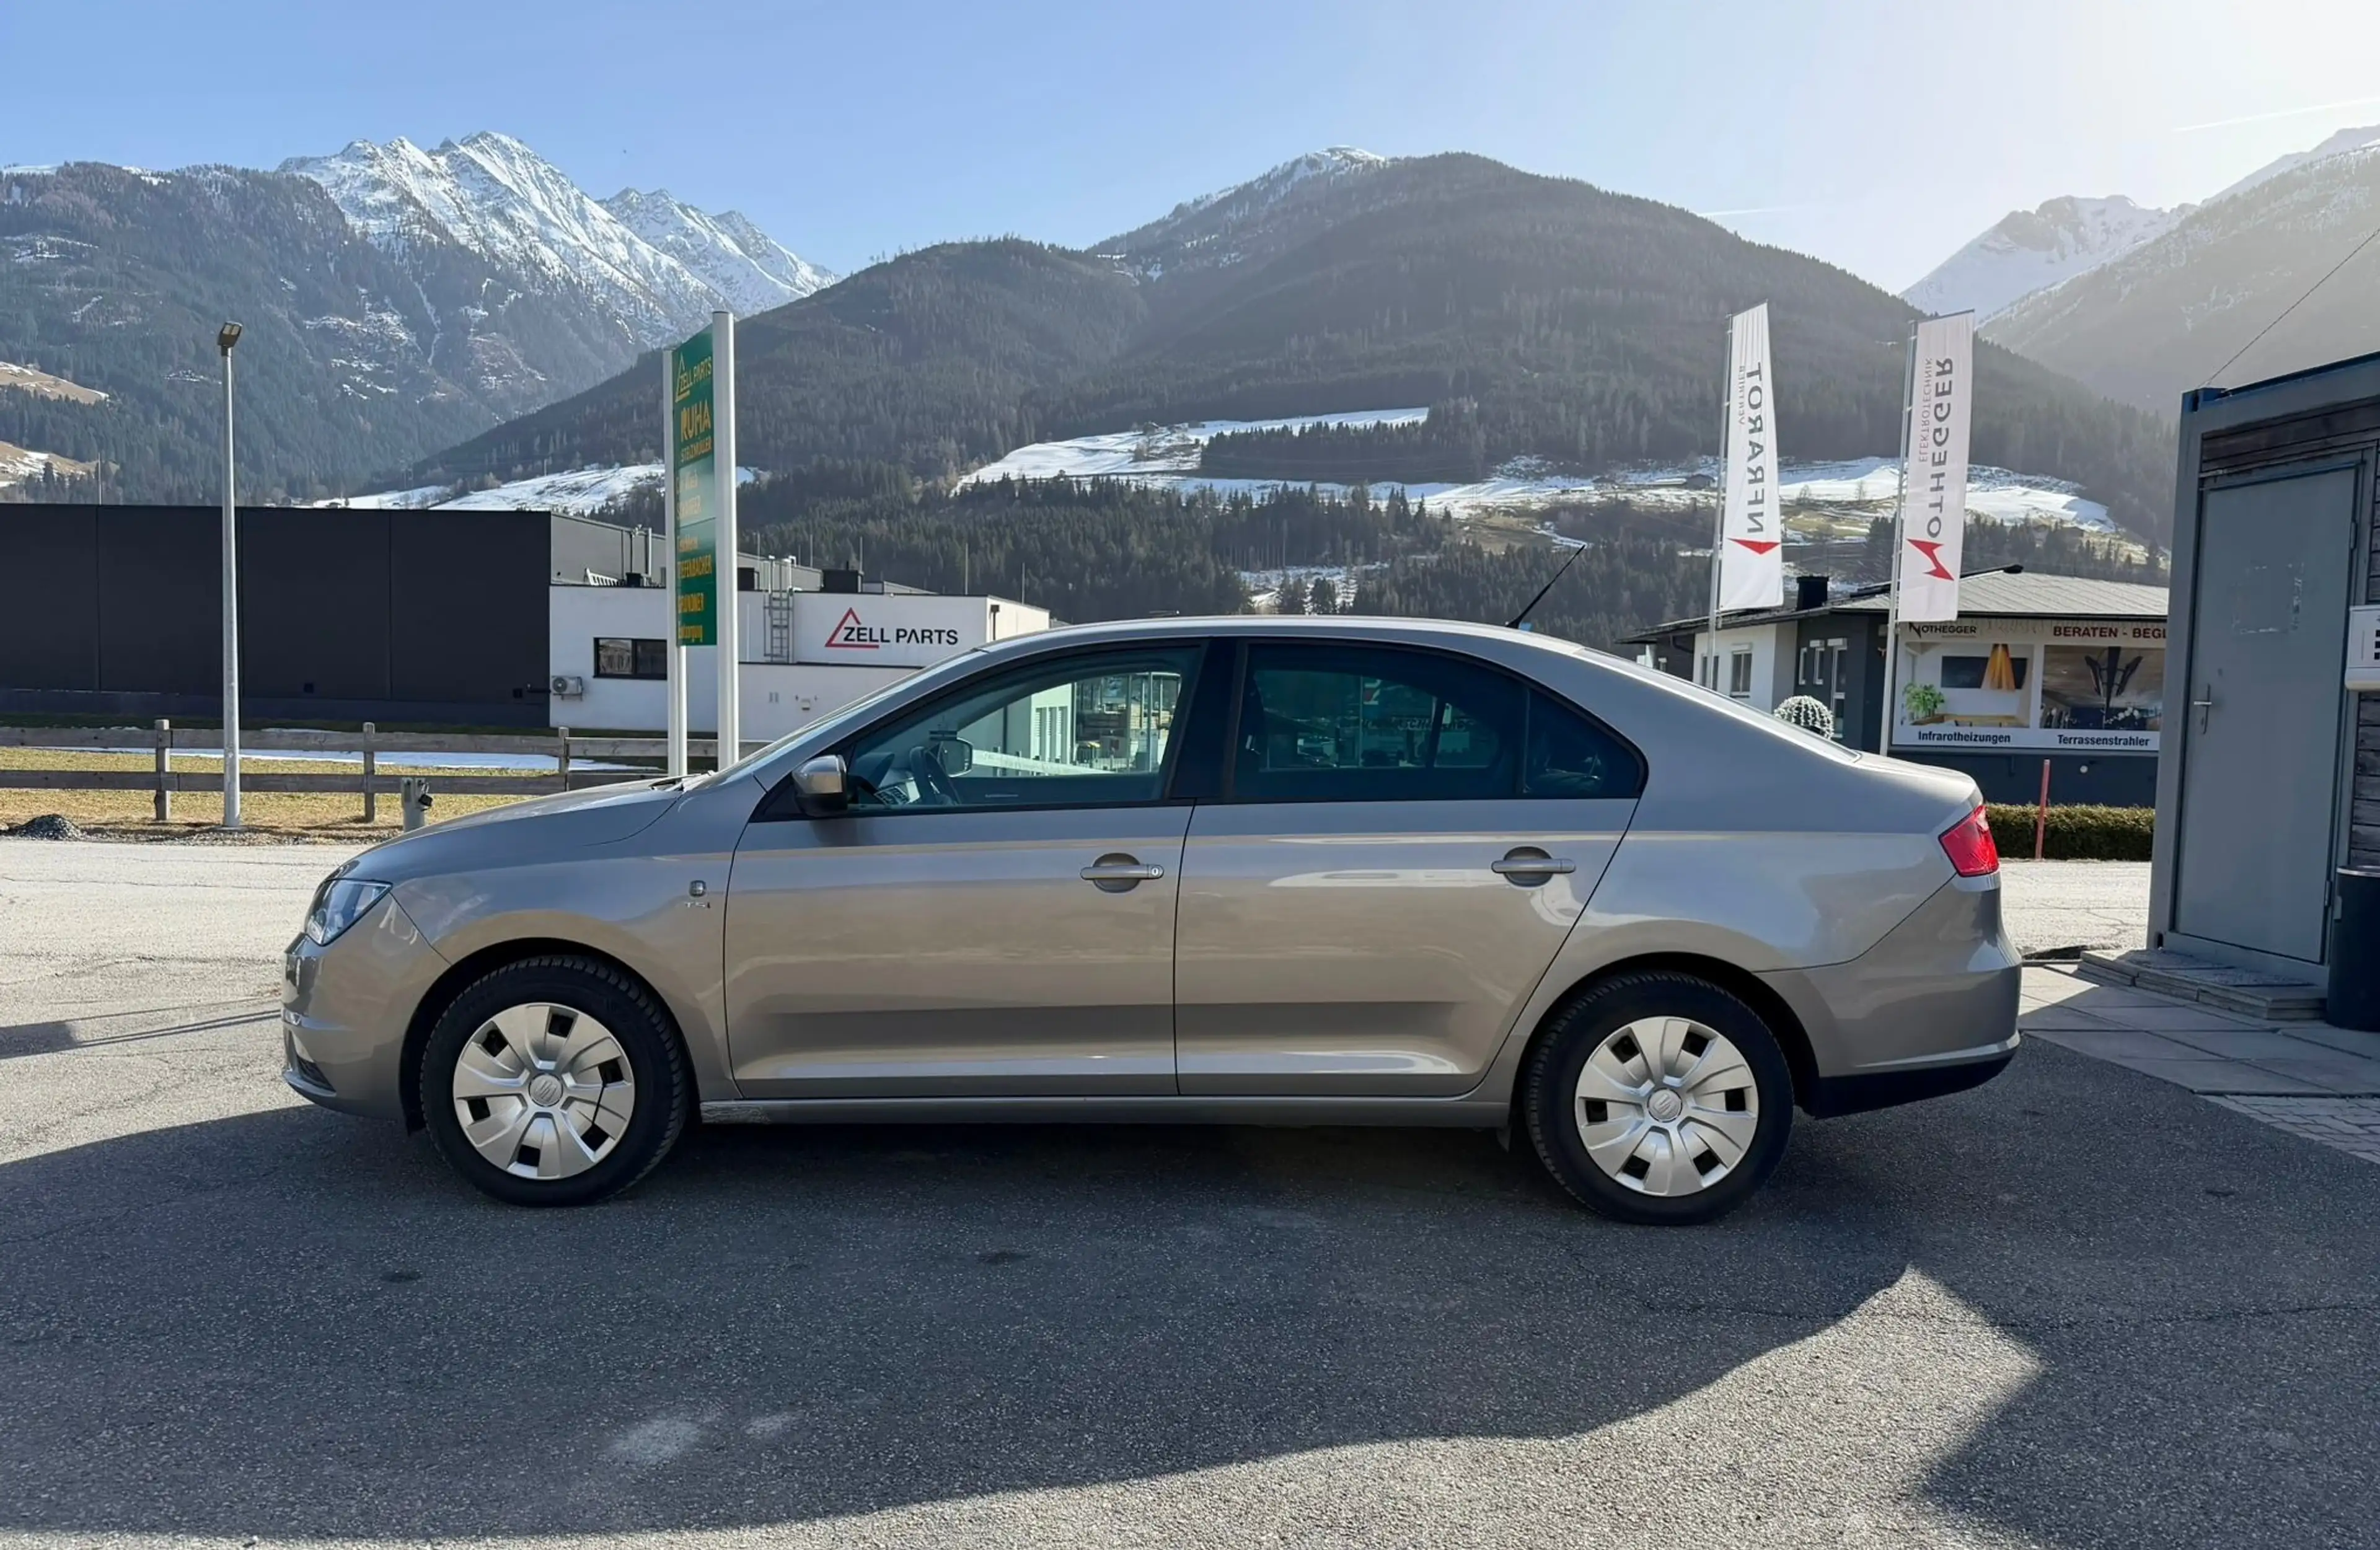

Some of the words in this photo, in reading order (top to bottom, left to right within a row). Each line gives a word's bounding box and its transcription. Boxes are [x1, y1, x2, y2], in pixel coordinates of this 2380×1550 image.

[681, 399, 712, 443] RUHA
[844, 627, 890, 643] ZELL
[896, 628, 958, 645] PARTS
[1909, 622, 1977, 639] NOTHEGGER
[2053, 626, 2118, 638] BERATEN
[1918, 731, 2011, 744] Infrarotheizungen
[2057, 734, 2150, 747] Terrassenstrahler
